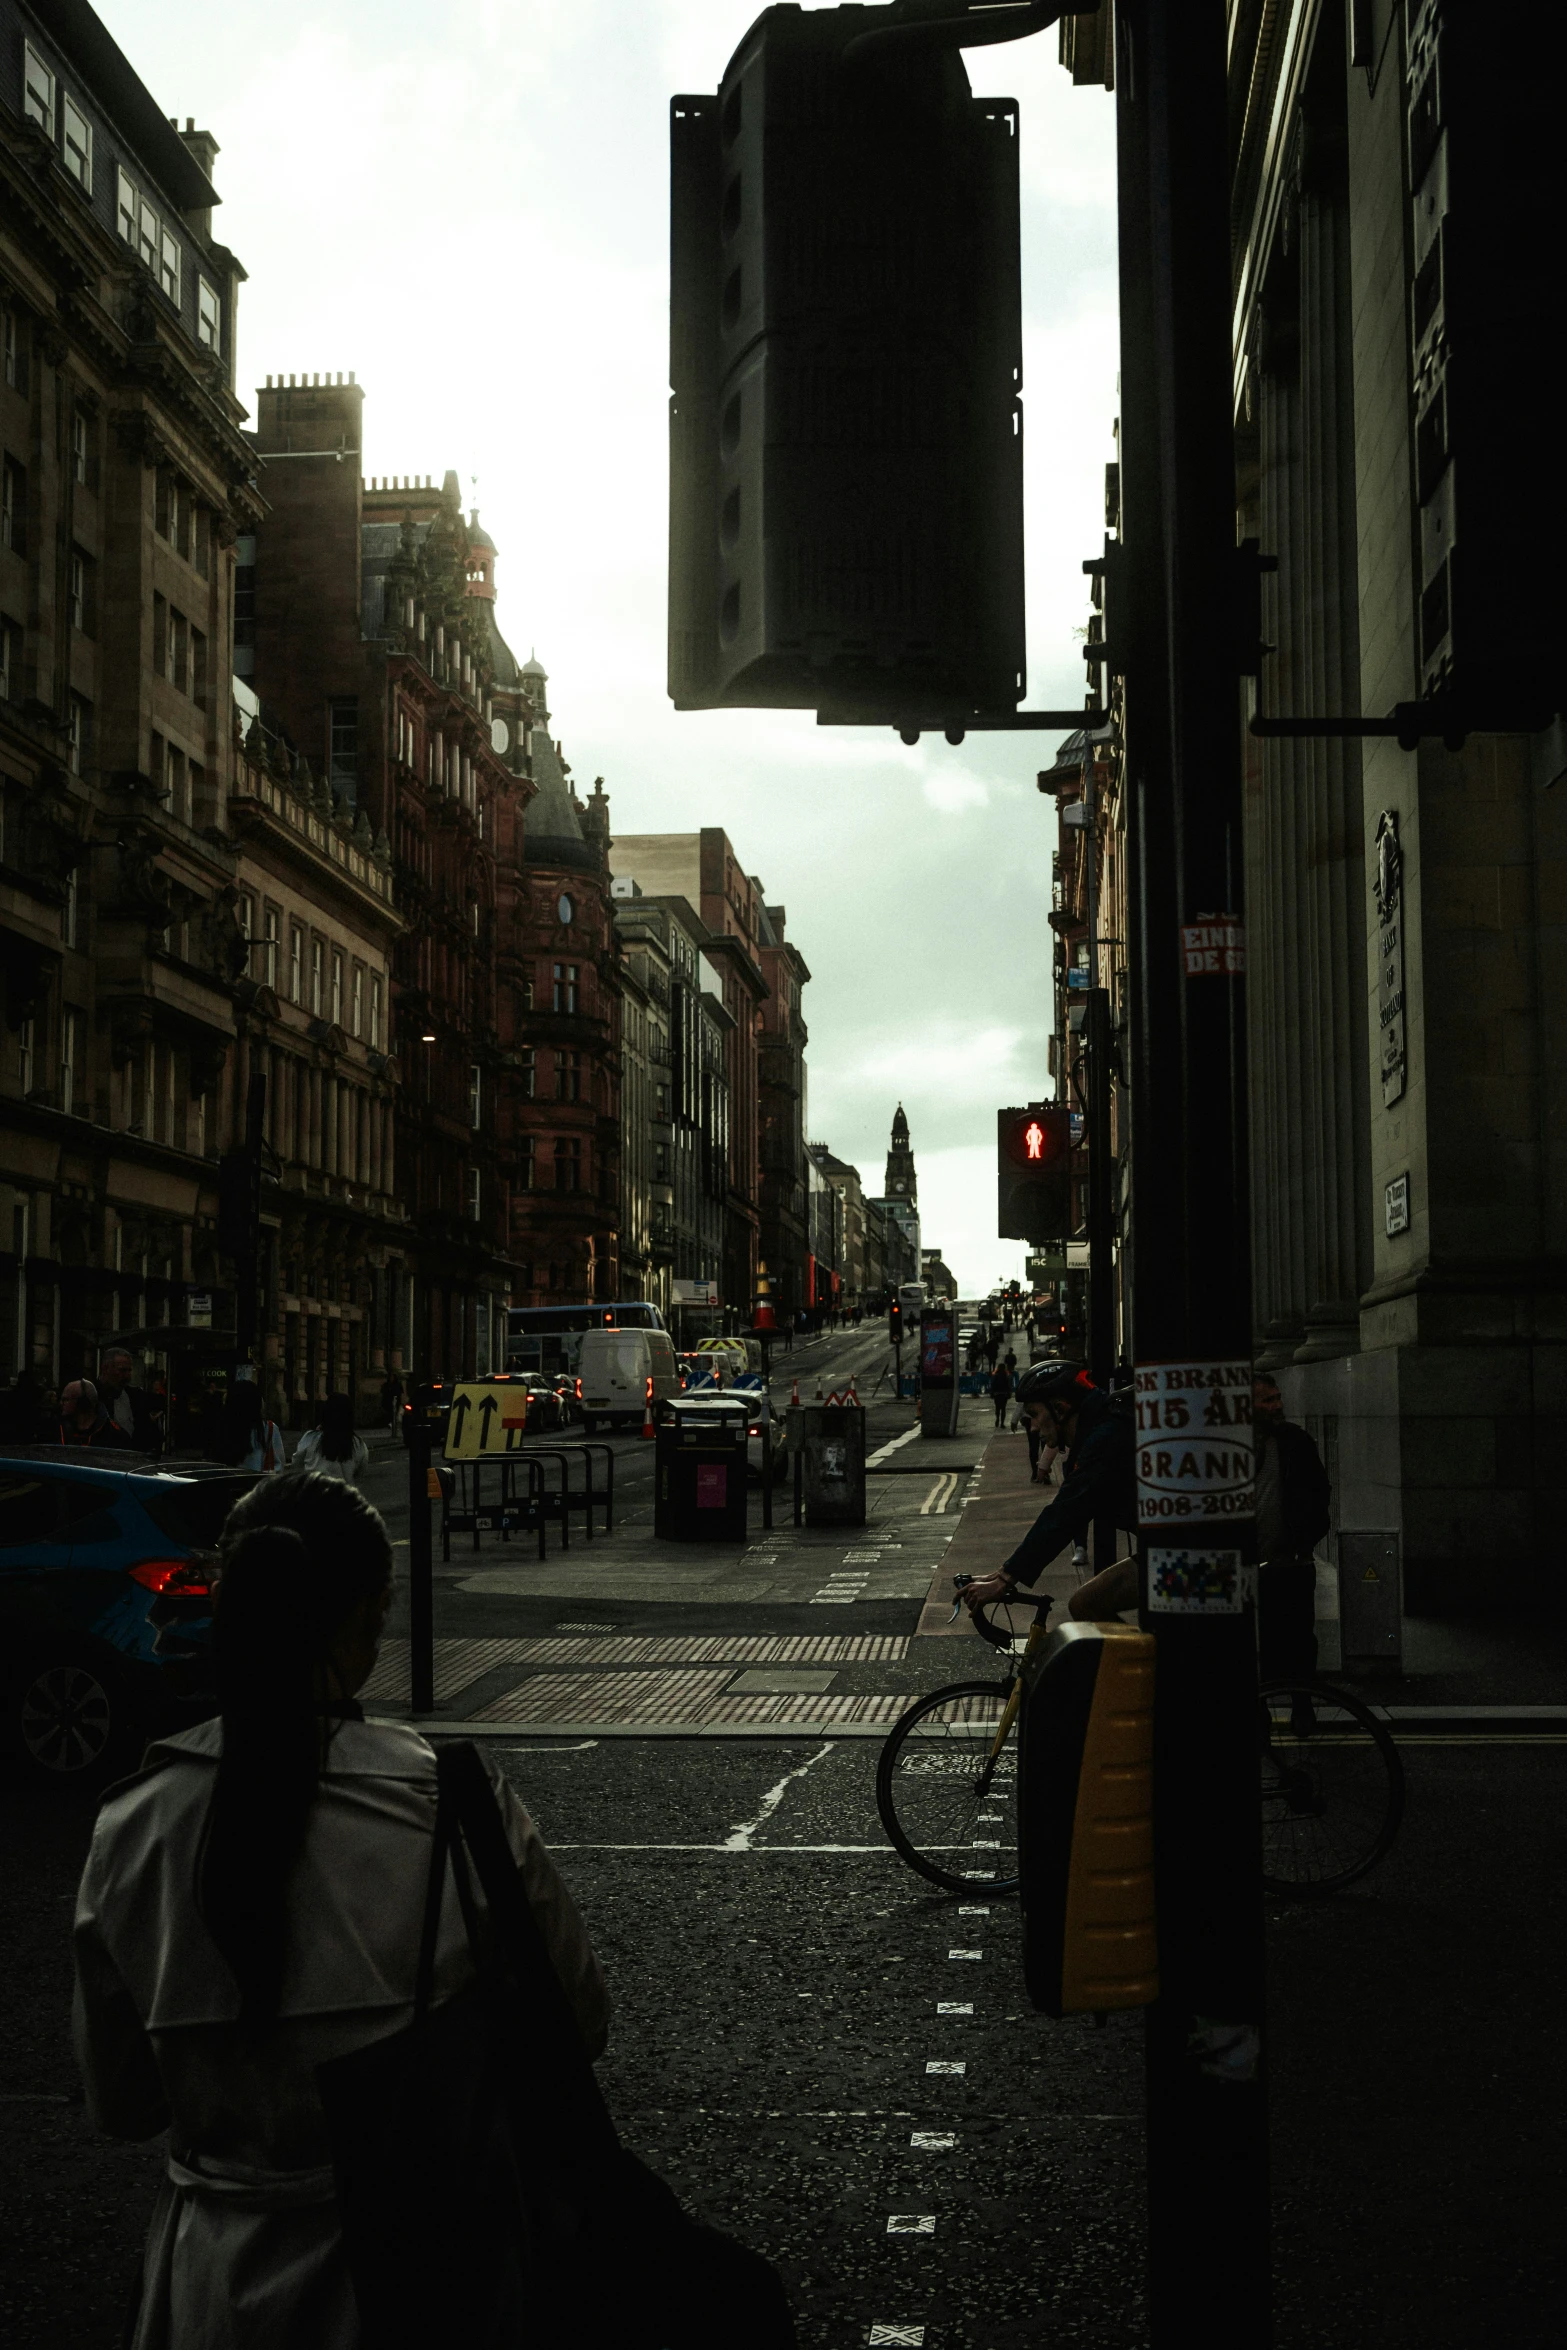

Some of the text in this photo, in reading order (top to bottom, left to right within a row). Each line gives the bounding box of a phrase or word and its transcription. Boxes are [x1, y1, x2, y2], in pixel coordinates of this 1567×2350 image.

[1383, 926, 1396, 958] BANK
[1186, 951, 1220, 973] DE
[1386, 964, 1394, 988] OF
[1380, 991, 1401, 1030] SCOTLAND
[1135, 1367, 1250, 1393] SK BRANN
[1136, 1389, 1252, 1430] 115 ÅR
[1142, 1451, 1249, 1478] BRANN
[502, 1517, 510, 1527] P
